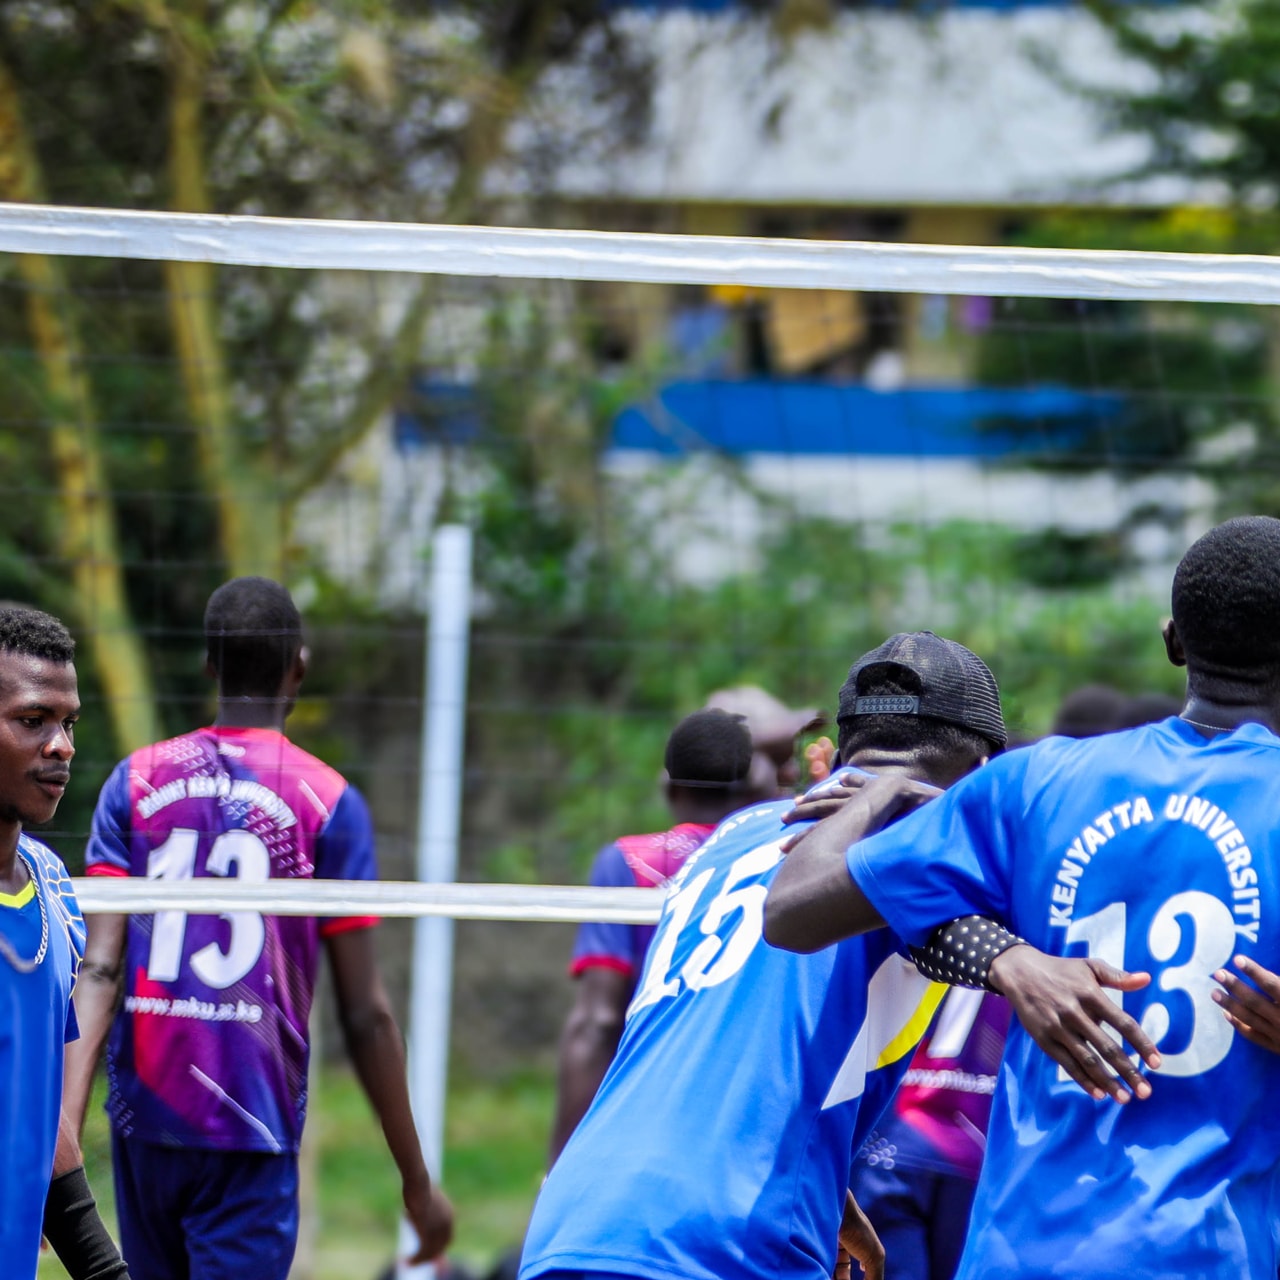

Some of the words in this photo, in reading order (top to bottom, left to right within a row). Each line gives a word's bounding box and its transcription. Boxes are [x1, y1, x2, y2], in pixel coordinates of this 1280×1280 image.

[146, 827, 271, 990] 13
[625, 832, 797, 1020] 15
[1049, 797, 1154, 927] KENYATTA
[1165, 794, 1260, 944] UNIVERSITY
[1058, 890, 1236, 1083] 13
